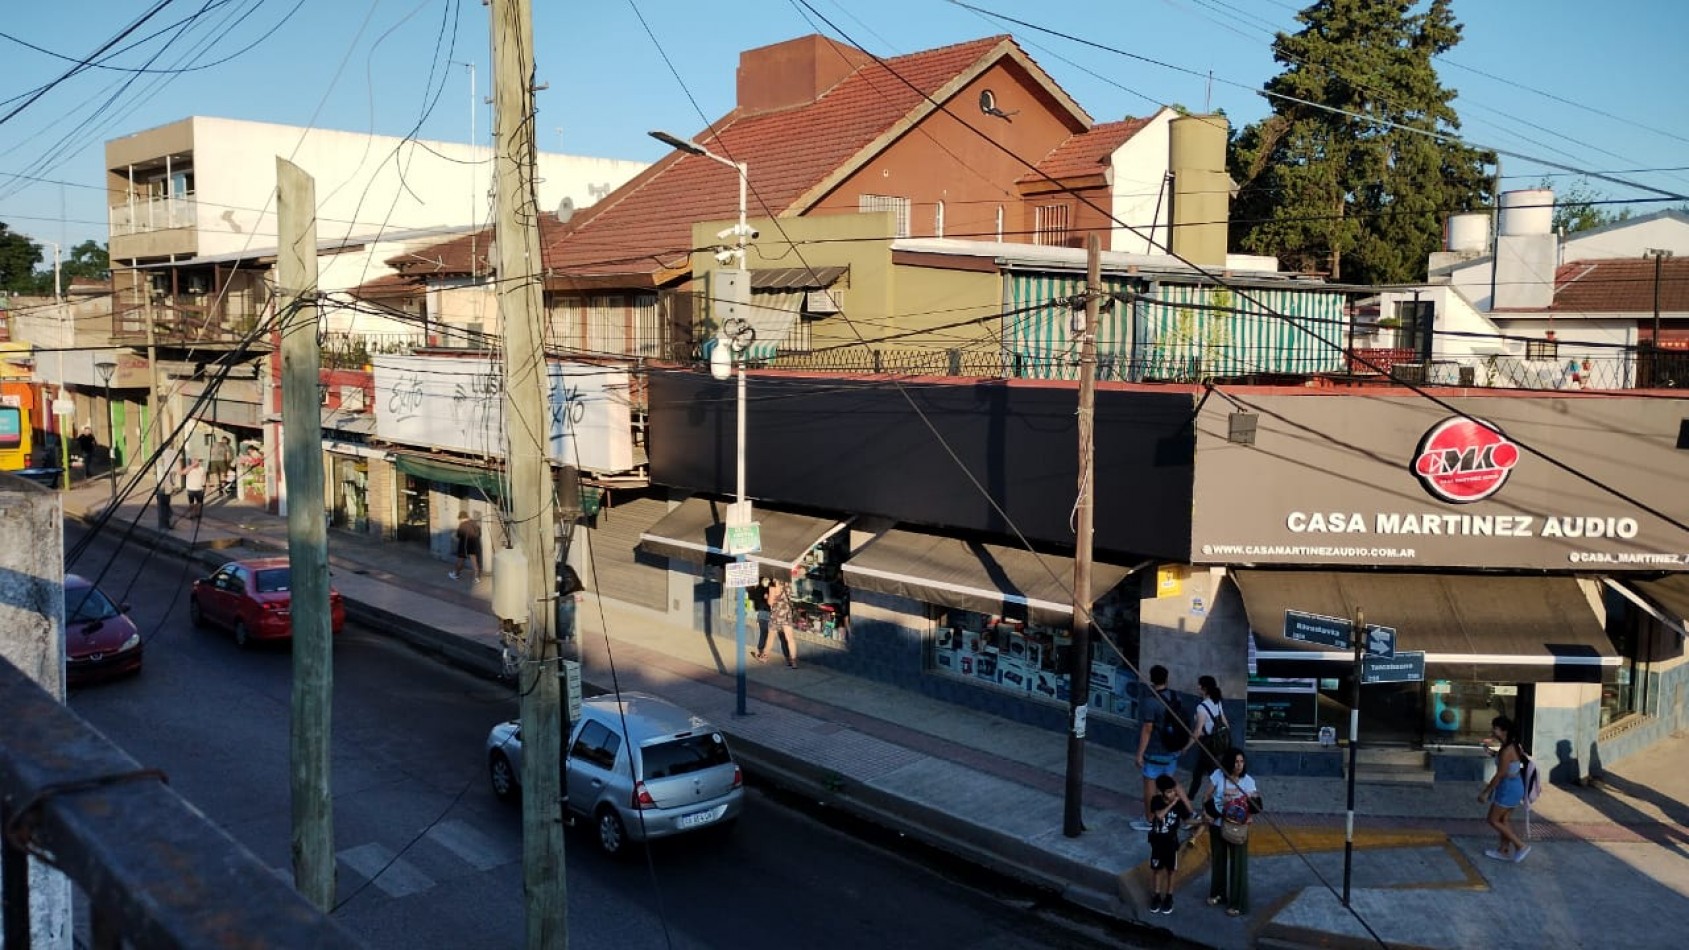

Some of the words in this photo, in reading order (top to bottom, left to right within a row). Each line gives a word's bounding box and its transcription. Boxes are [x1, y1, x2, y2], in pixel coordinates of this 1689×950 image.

[1287, 512, 1366, 533] CASA
[1376, 513, 1533, 538] MARTINEZ
[1540, 516, 1639, 539] AUDIO
